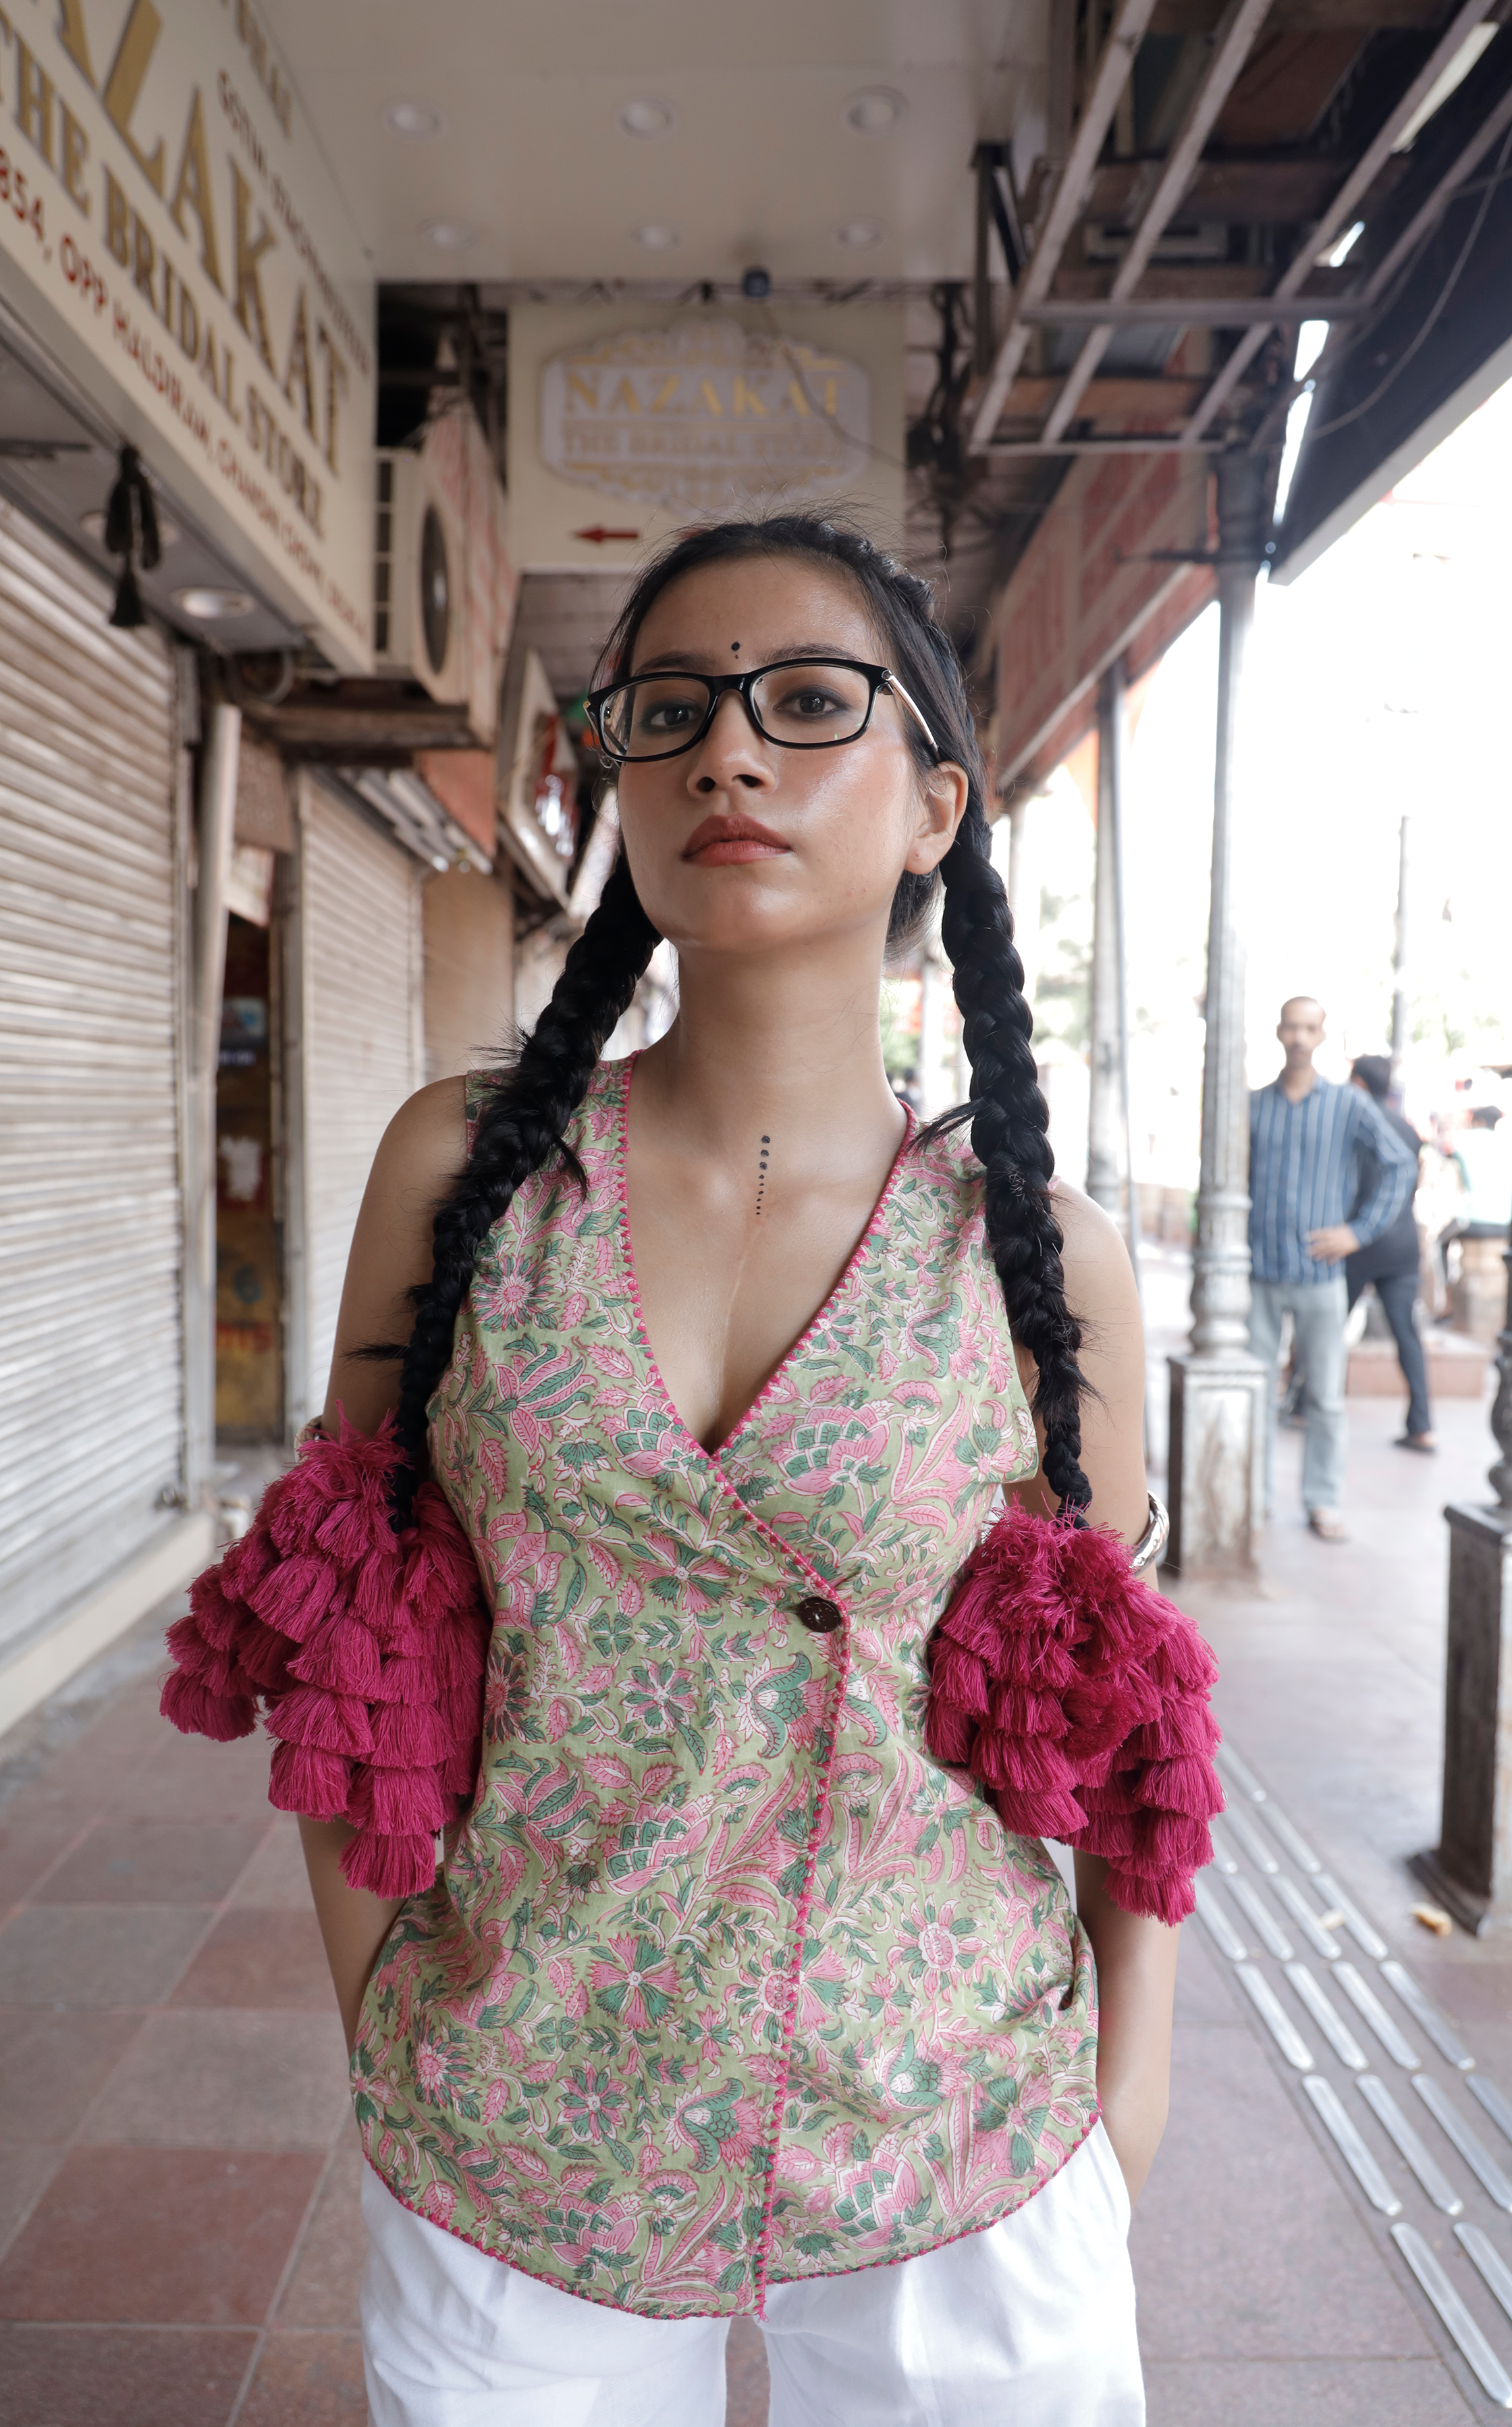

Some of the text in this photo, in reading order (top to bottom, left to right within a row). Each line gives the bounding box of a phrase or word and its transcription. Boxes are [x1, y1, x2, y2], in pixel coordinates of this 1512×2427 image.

[59, 233, 109, 316] OPP
[103, 161, 241, 427] BRIDAL
[564, 373, 846, 417] NAZAKAT
